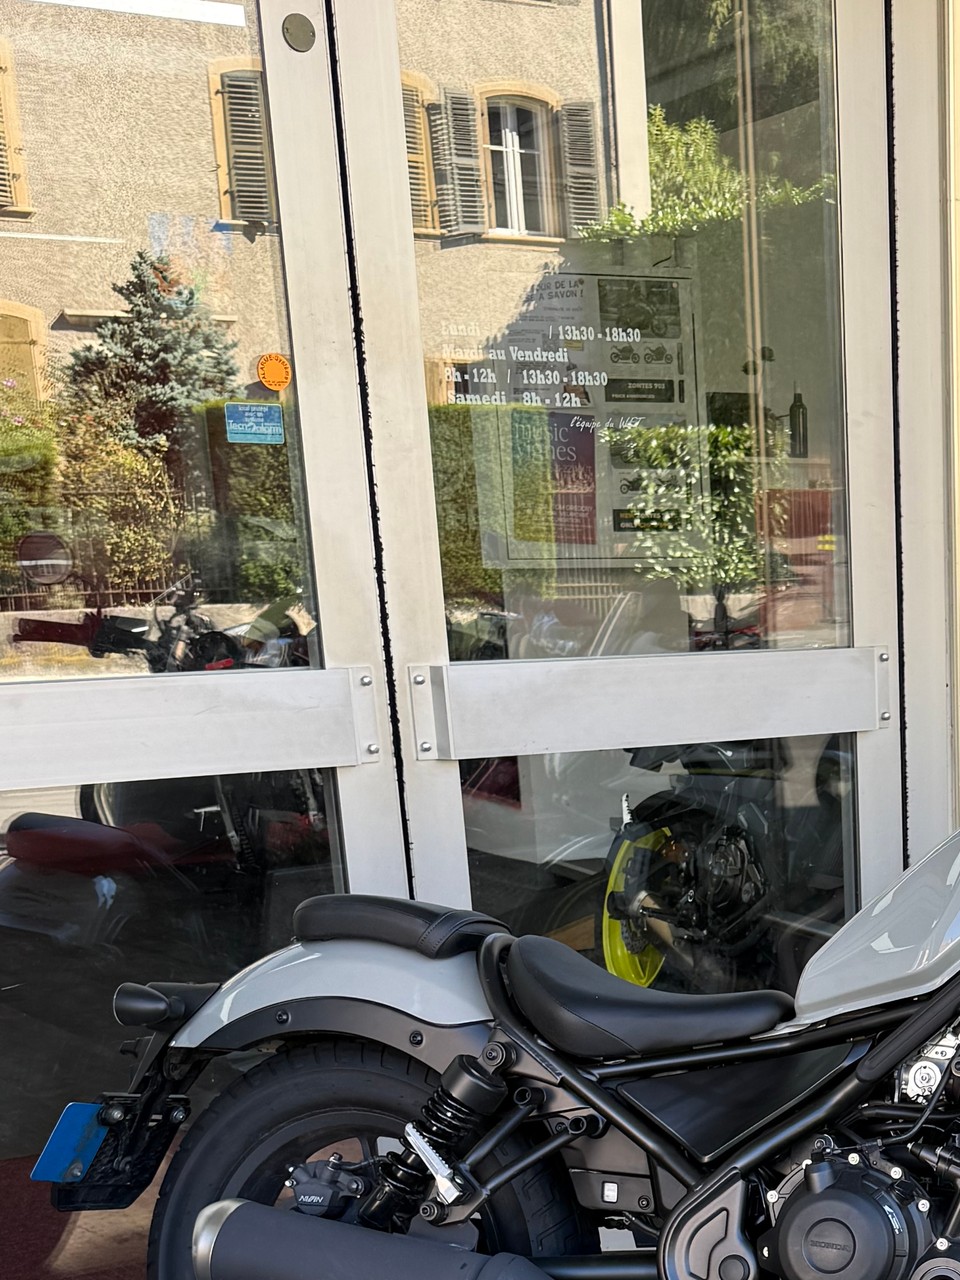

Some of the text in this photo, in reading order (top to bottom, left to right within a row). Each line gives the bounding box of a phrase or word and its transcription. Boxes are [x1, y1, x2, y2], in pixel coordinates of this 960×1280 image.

[547, 290, 577, 299] SAVON
[441, 321, 480, 336] Lundi
[558, 325, 594, 340] 13h30
[605, 327, 640, 342] 18h30
[442, 344, 568, 362] Mardi au Vendredi
[445, 367, 462, 382] 8h
[473, 368, 496, 382] 12h
[522, 369, 560, 385] 13h30
[571, 371, 608, 386] 18h30
[448, 391, 506, 405] Samedi
[523, 392, 541, 405] 8h
[555, 393, 581, 407] 12h
[605, 418, 614, 428] du
[810, 1239, 852, 1251] HONDA
